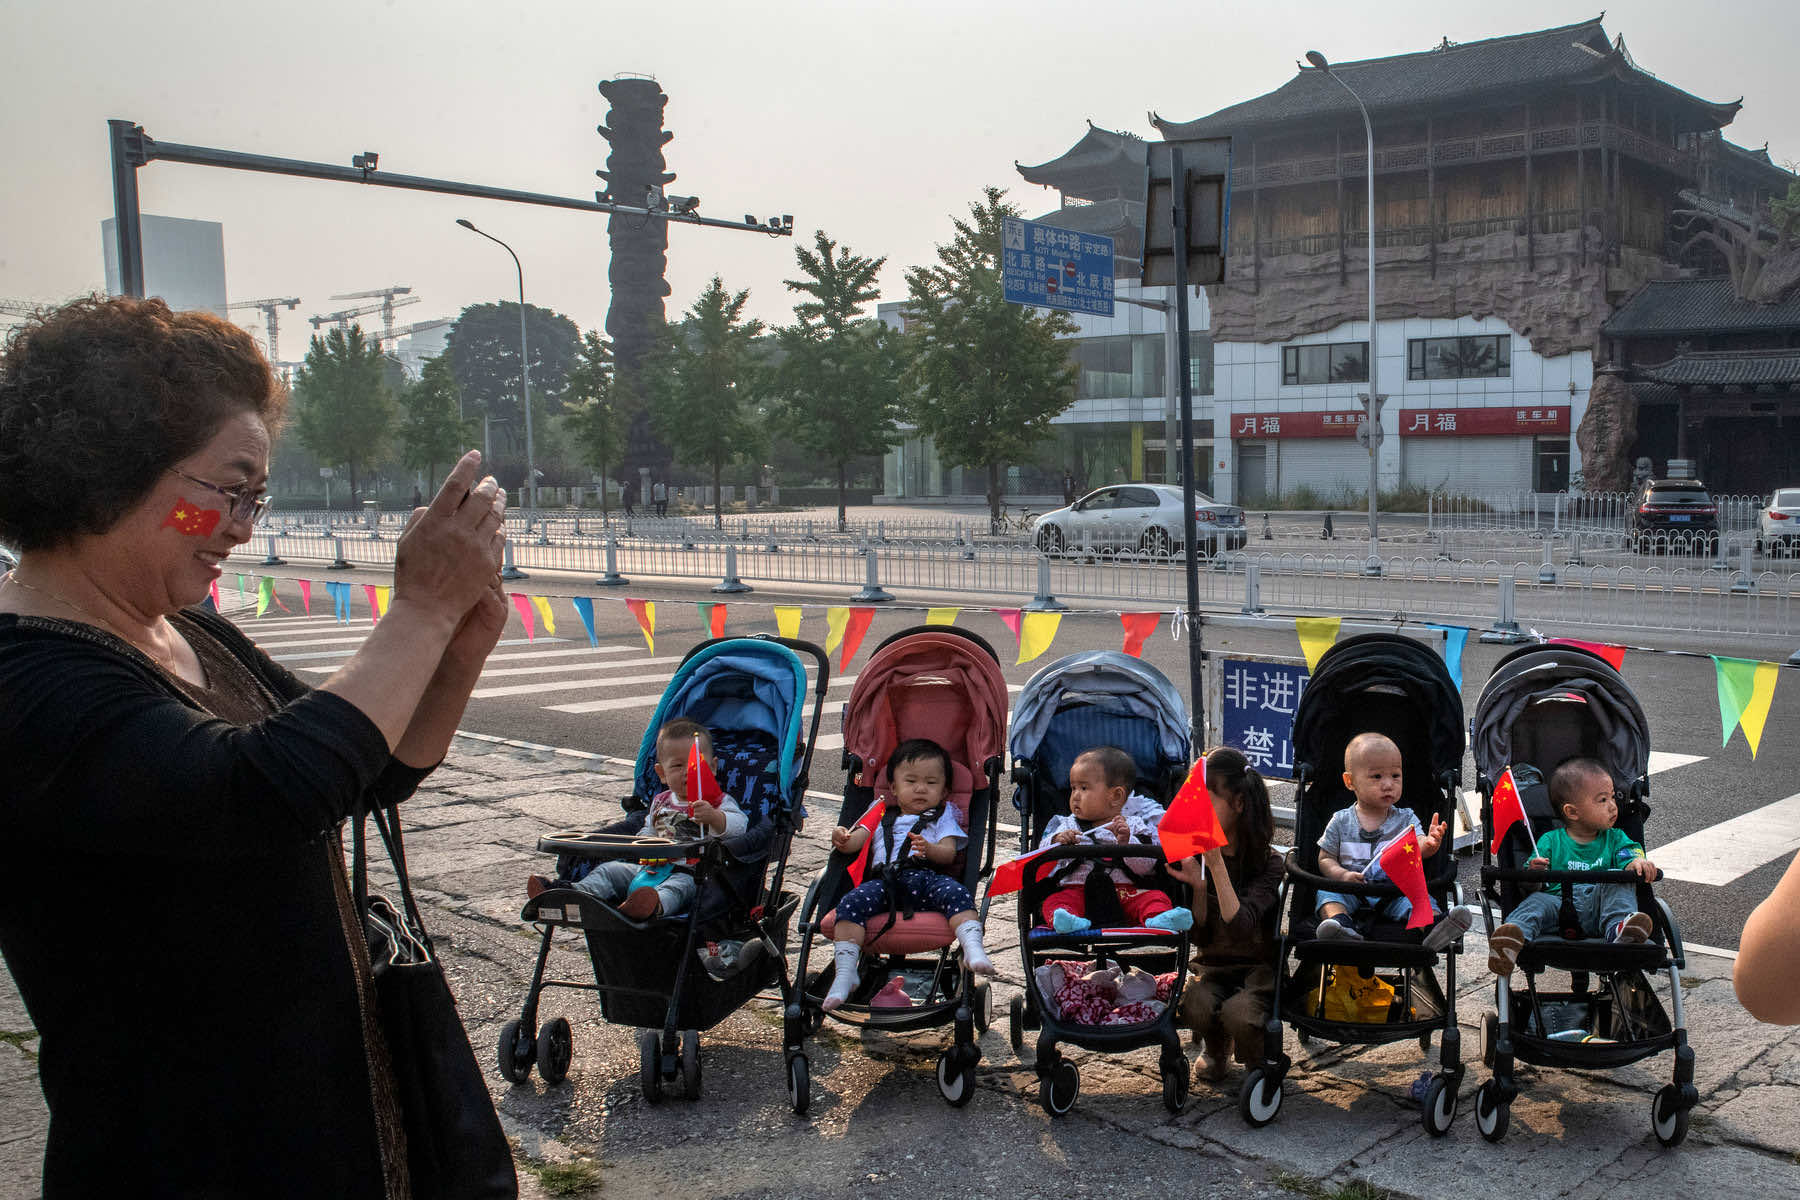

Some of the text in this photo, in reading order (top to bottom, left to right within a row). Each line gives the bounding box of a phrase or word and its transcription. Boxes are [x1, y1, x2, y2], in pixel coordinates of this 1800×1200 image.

[1033, 227, 1080, 253] 奥体中路
[1007, 251, 1047, 272] 北辰路
[1077, 271, 1113, 291] 北辰路
[1239, 417, 1281, 433] 月福
[1408, 413, 1457, 431] 月福
[1567, 860, 1590, 871] SUPER
